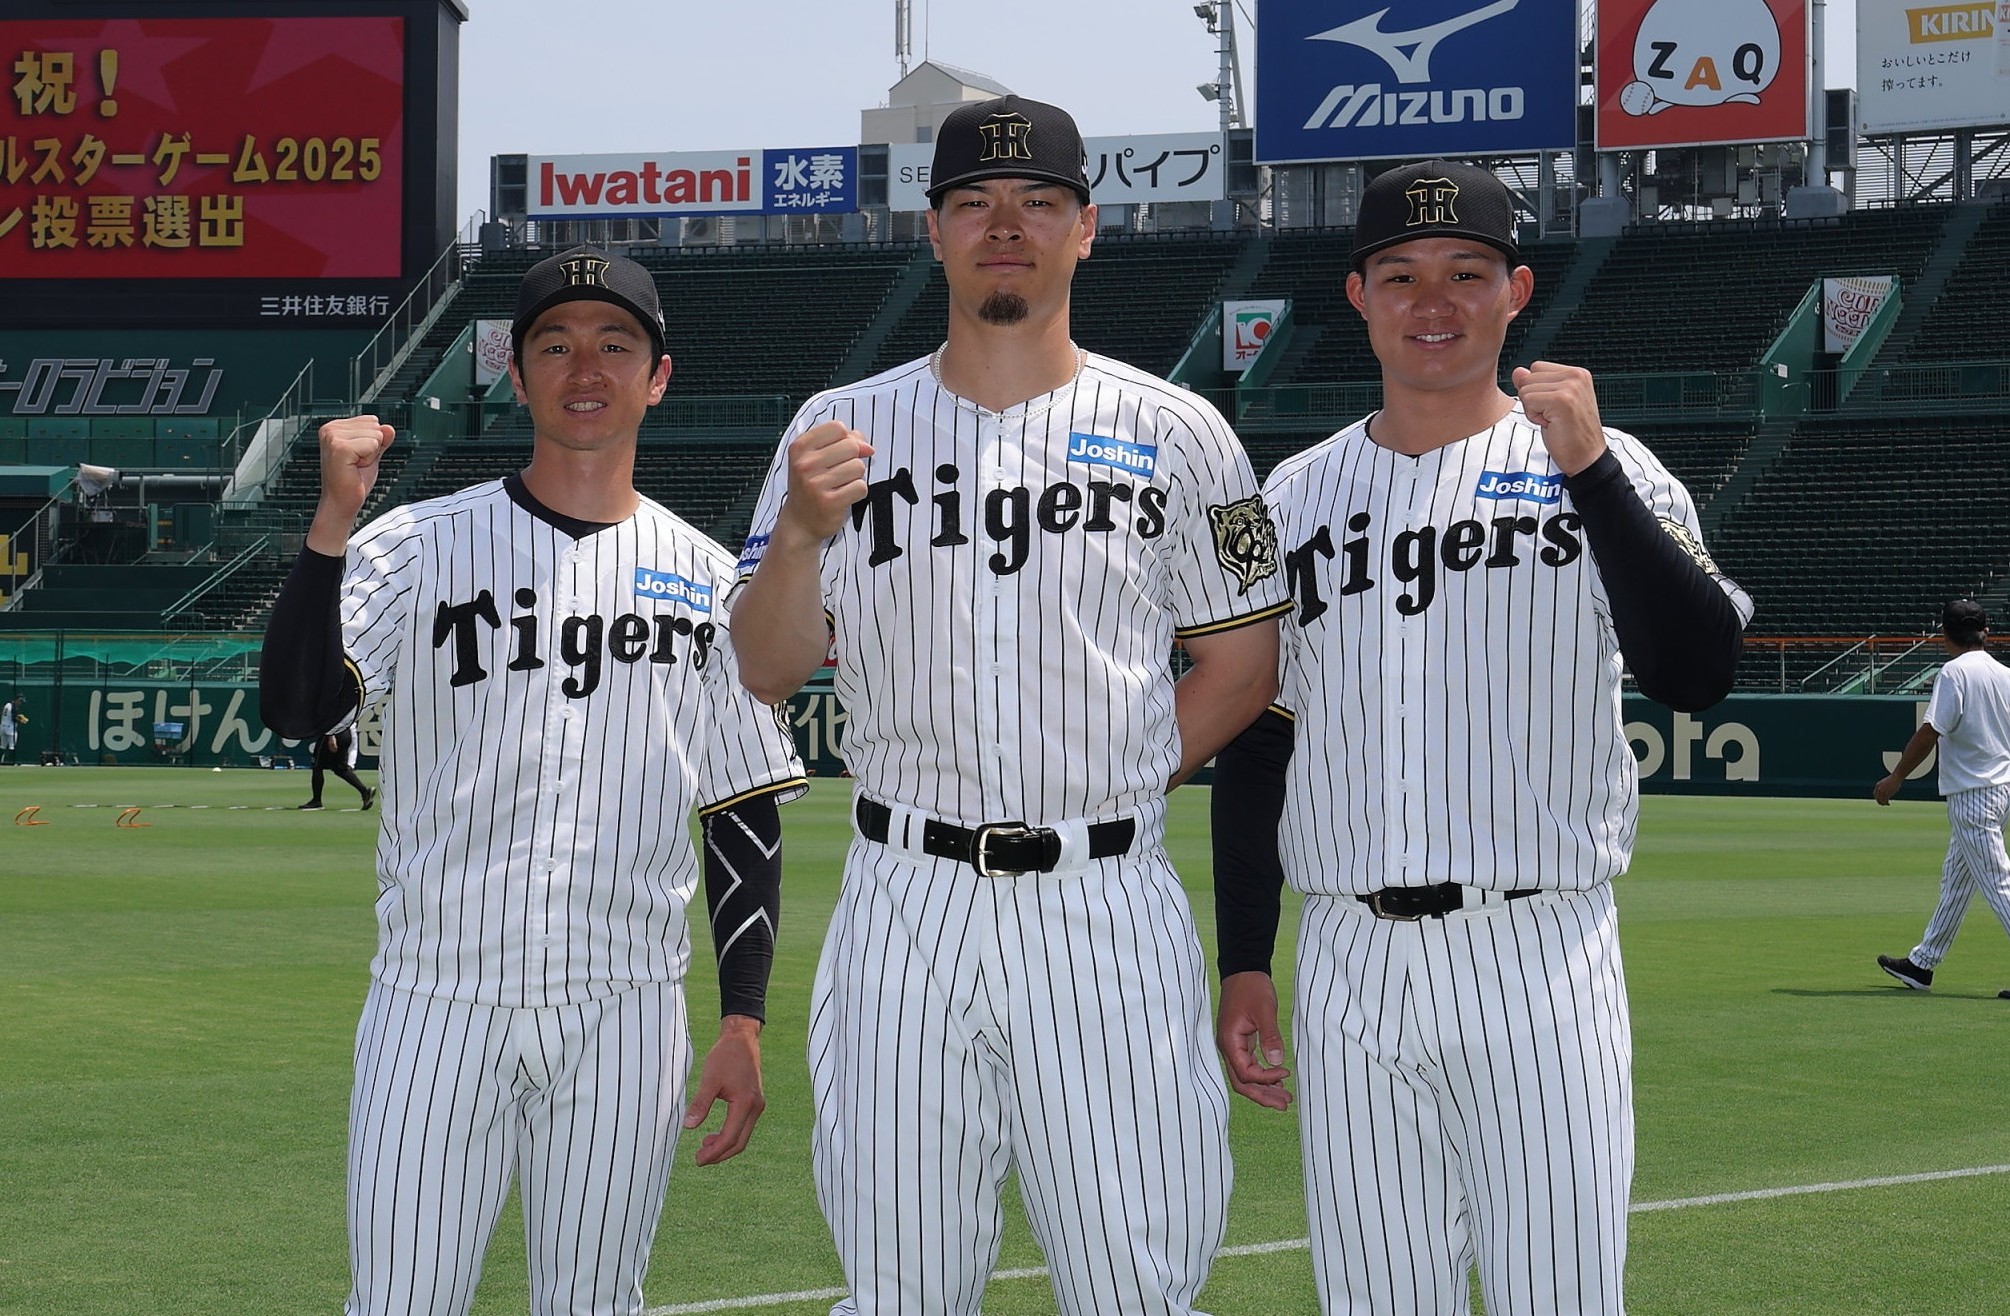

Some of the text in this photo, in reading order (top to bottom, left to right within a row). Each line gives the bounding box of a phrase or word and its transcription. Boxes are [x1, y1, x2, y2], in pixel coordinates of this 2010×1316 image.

[1921, 9, 1994, 36] KIRIN
[1648, 41, 1764, 91] ZAQ
[1882, 51, 1971, 68] おいしいとこだけ
[1303, 83, 1525, 129] MIZUNO
[540, 157, 752, 207] Iwatani
[774, 154, 844, 191] 水素
[1092, 144, 1221, 189] パイプ
[774, 193, 844, 209] エネルギー
[260, 296, 389, 316] 三井住友銀行
[0, 358, 224, 414] ーロラビジョン
[1069, 436, 1155, 470] Joshin
[1479, 475, 1561, 499] Joshin
[851, 463, 1168, 576] Tigers
[635, 572, 711, 608] Joshin
[1286, 511, 1583, 628] Tigers
[432, 587, 716, 700] Tigers
